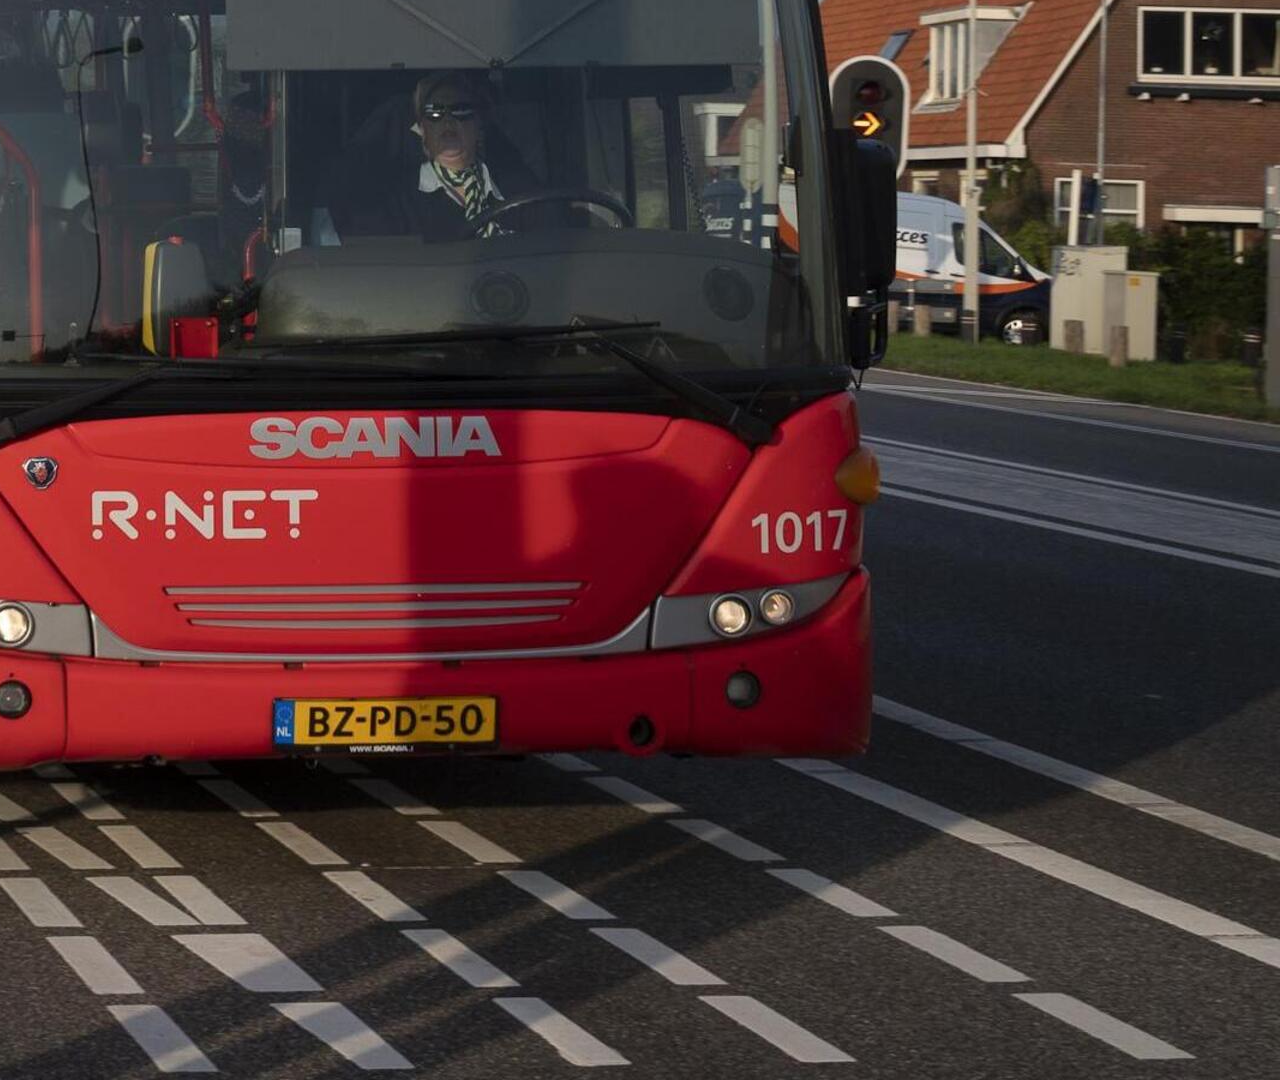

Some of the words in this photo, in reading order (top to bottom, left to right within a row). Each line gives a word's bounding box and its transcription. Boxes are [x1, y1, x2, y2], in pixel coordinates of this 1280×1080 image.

[248, 415, 503, 460] SCANIA
[751, 509, 848, 554] 1017
[276, 727, 292, 737] NL
[308, 704, 486, 737] BZ-PD-50
